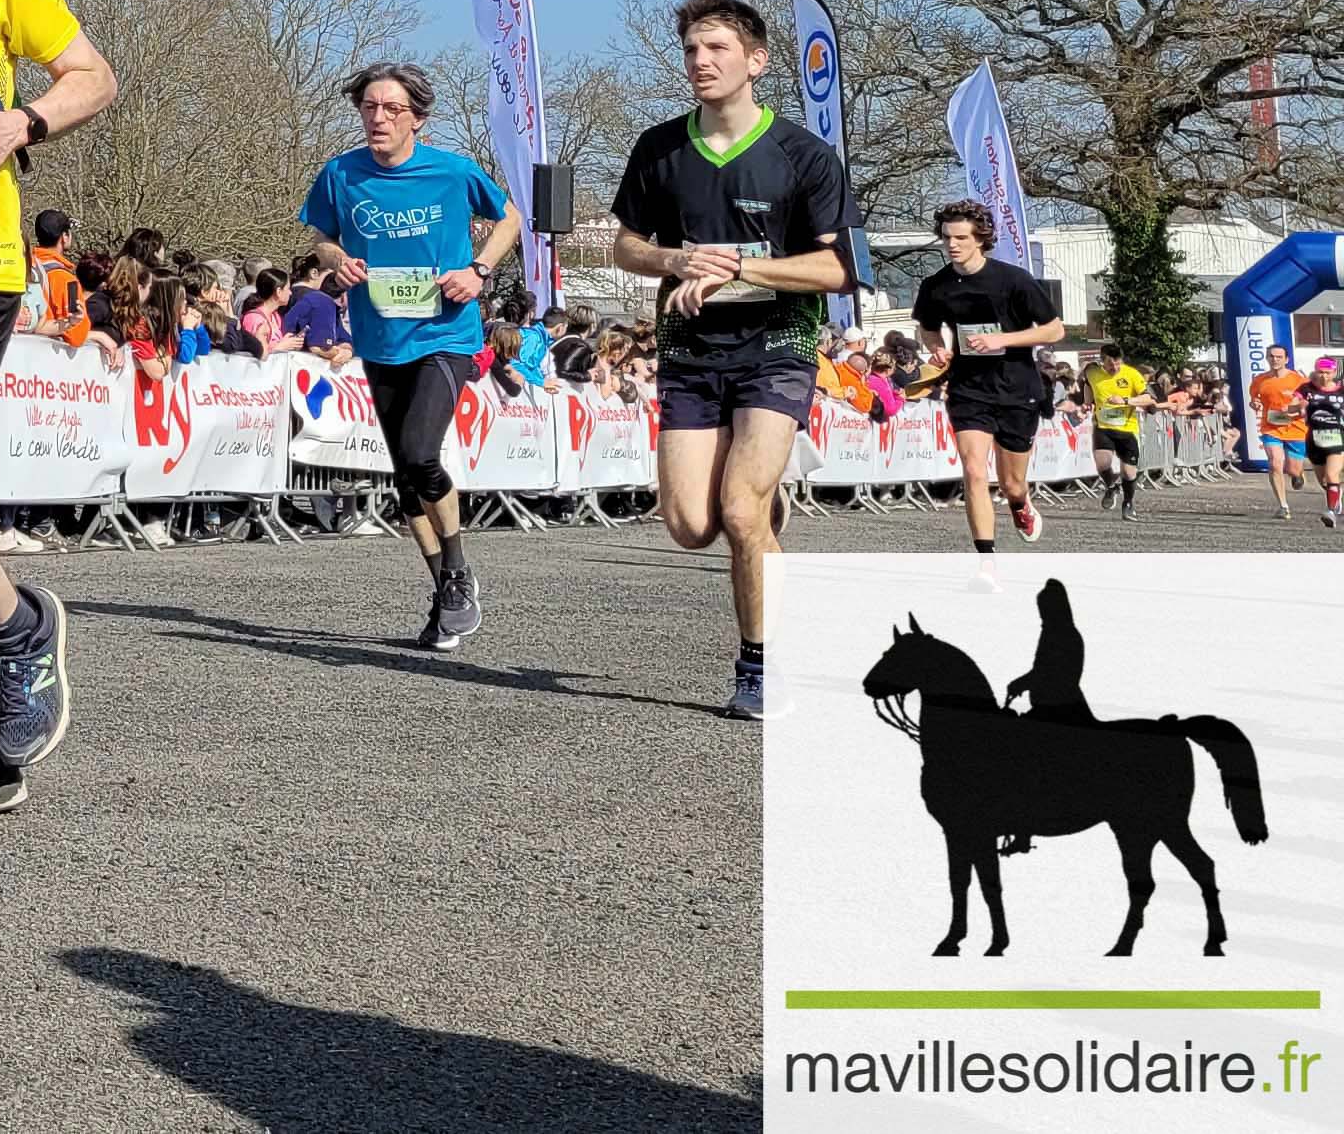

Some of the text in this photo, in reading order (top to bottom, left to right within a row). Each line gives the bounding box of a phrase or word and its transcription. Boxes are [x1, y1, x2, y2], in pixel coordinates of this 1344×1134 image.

[389, 285, 420, 297] 1637
[4, 372, 110, 405] Roche-sur-Yon
[191, 388, 212, 406] La
[9, 433, 23, 457] Le
[56, 432, 101, 462] Vendée
[344, 436, 357, 451] LA
